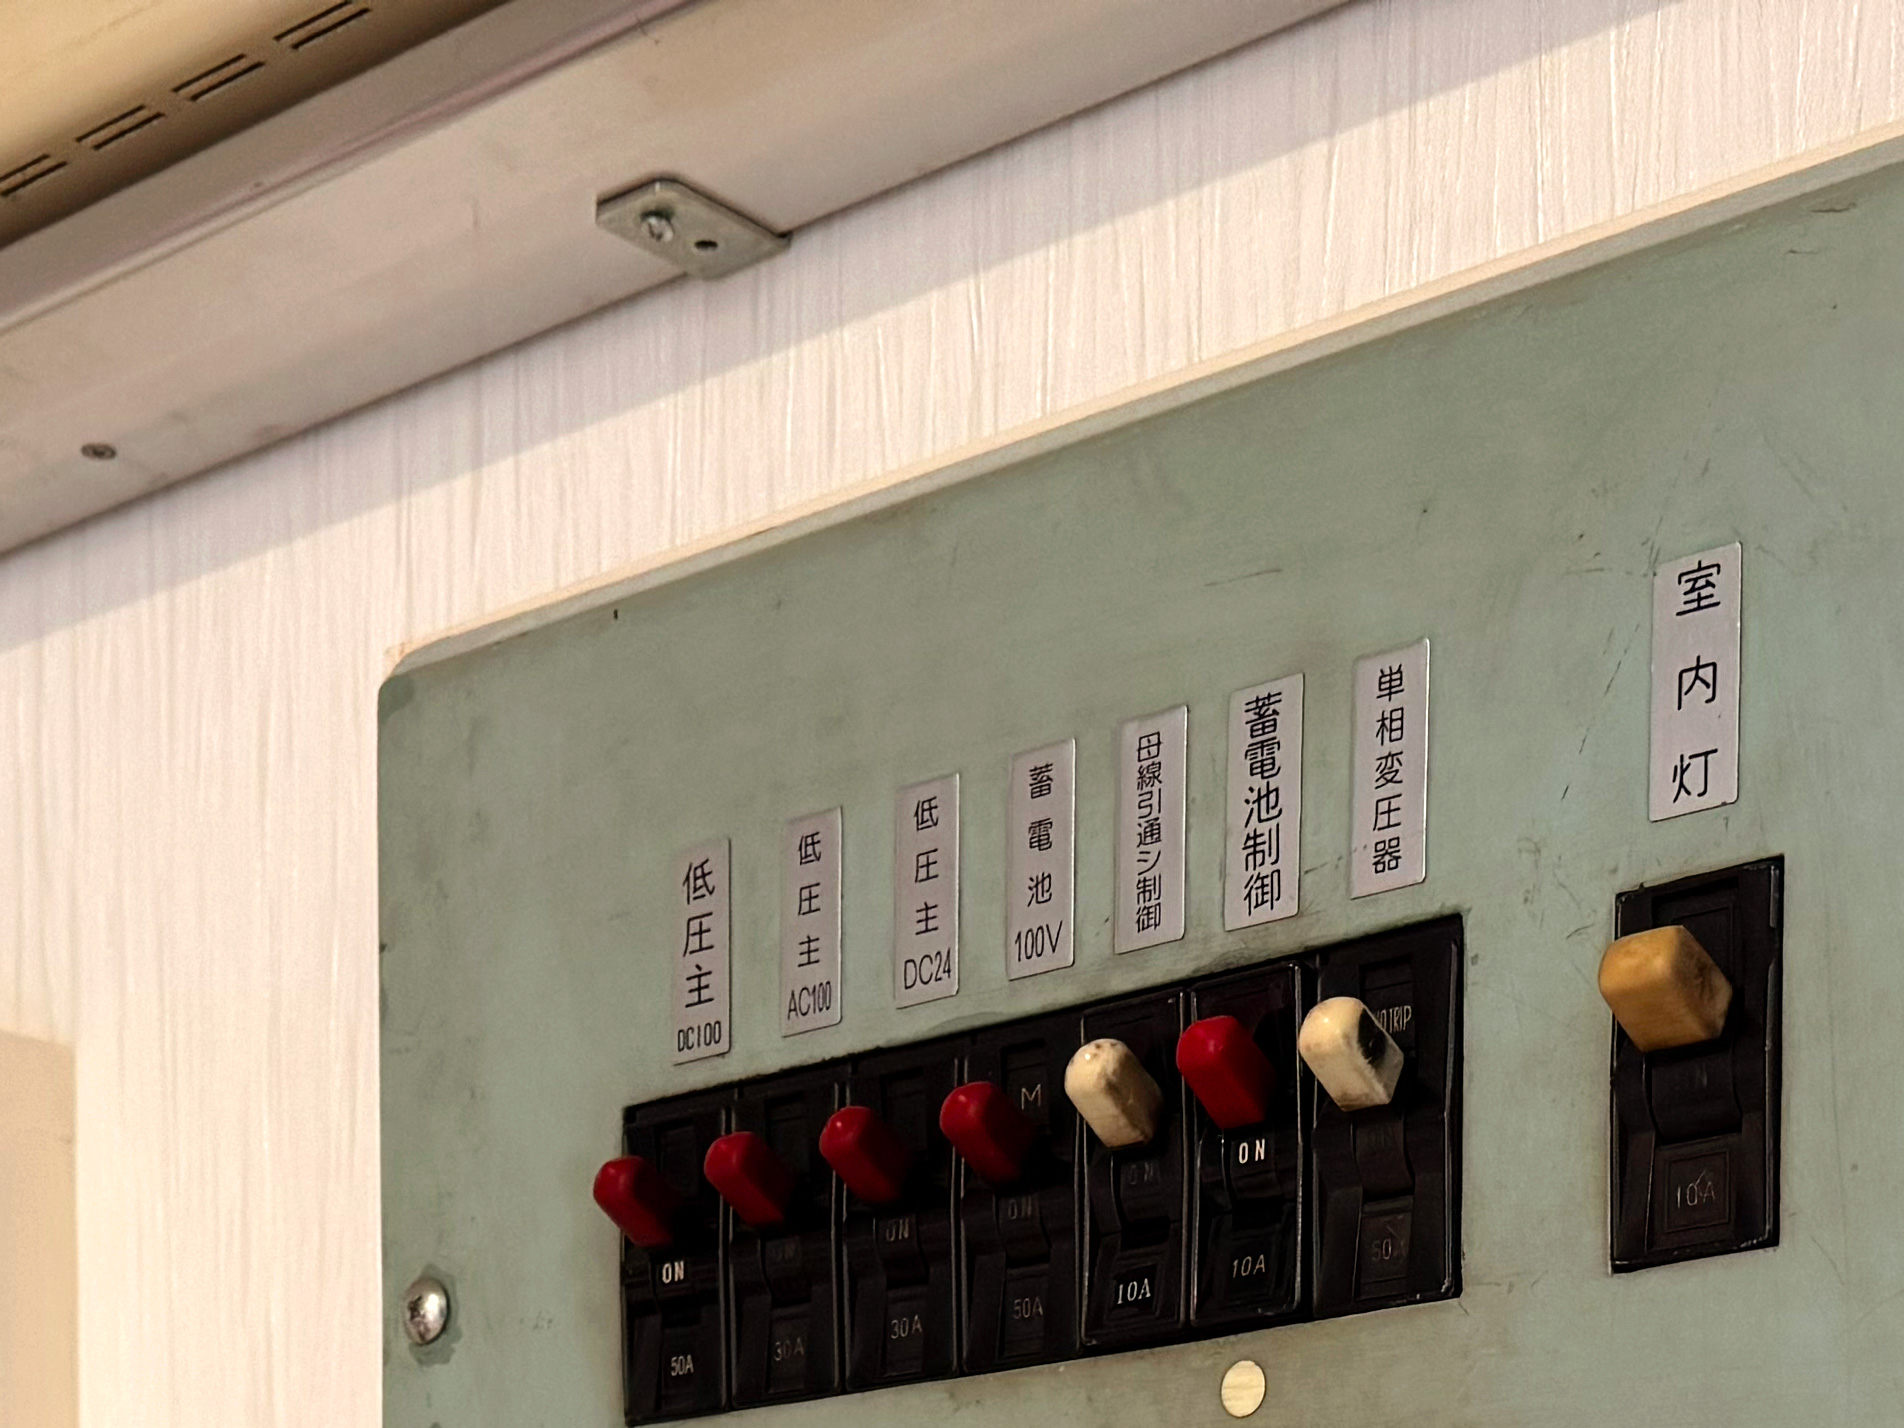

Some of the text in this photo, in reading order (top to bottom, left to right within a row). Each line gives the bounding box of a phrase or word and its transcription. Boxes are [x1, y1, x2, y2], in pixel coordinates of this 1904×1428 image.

[1672, 560, 1721, 801] 室内灯
[1373, 664, 1404, 874] 単相変圧器
[1242, 691, 1282, 916] 蓄電池制御
[1026, 763, 1054, 907] 蓄電池
[1135, 731, 1163, 934] 母線引通シ制御
[913, 796, 939, 935] 低圧主
[797, 831, 822, 968] 低圧主
[683, 859, 716, 1008] 低圧主
[1015, 920, 1063, 962] 100V
[903, 948, 952, 989] DC24
[787, 981, 832, 1020] AC100
[1388, 1005, 1413, 1035] TRIP
[677, 1021, 721, 1052] DC100
[1238, 1137, 1266, 1165] ON
[885, 1217, 910, 1243] ON
[661, 1260, 685, 1285] ON
[1232, 1252, 1266, 1279] 10A
[1012, 1296, 1044, 1320] 50A
[1117, 1277, 1151, 1305] 10A
[890, 1315, 923, 1339] 30A
[670, 1356, 694, 1377] 50A
